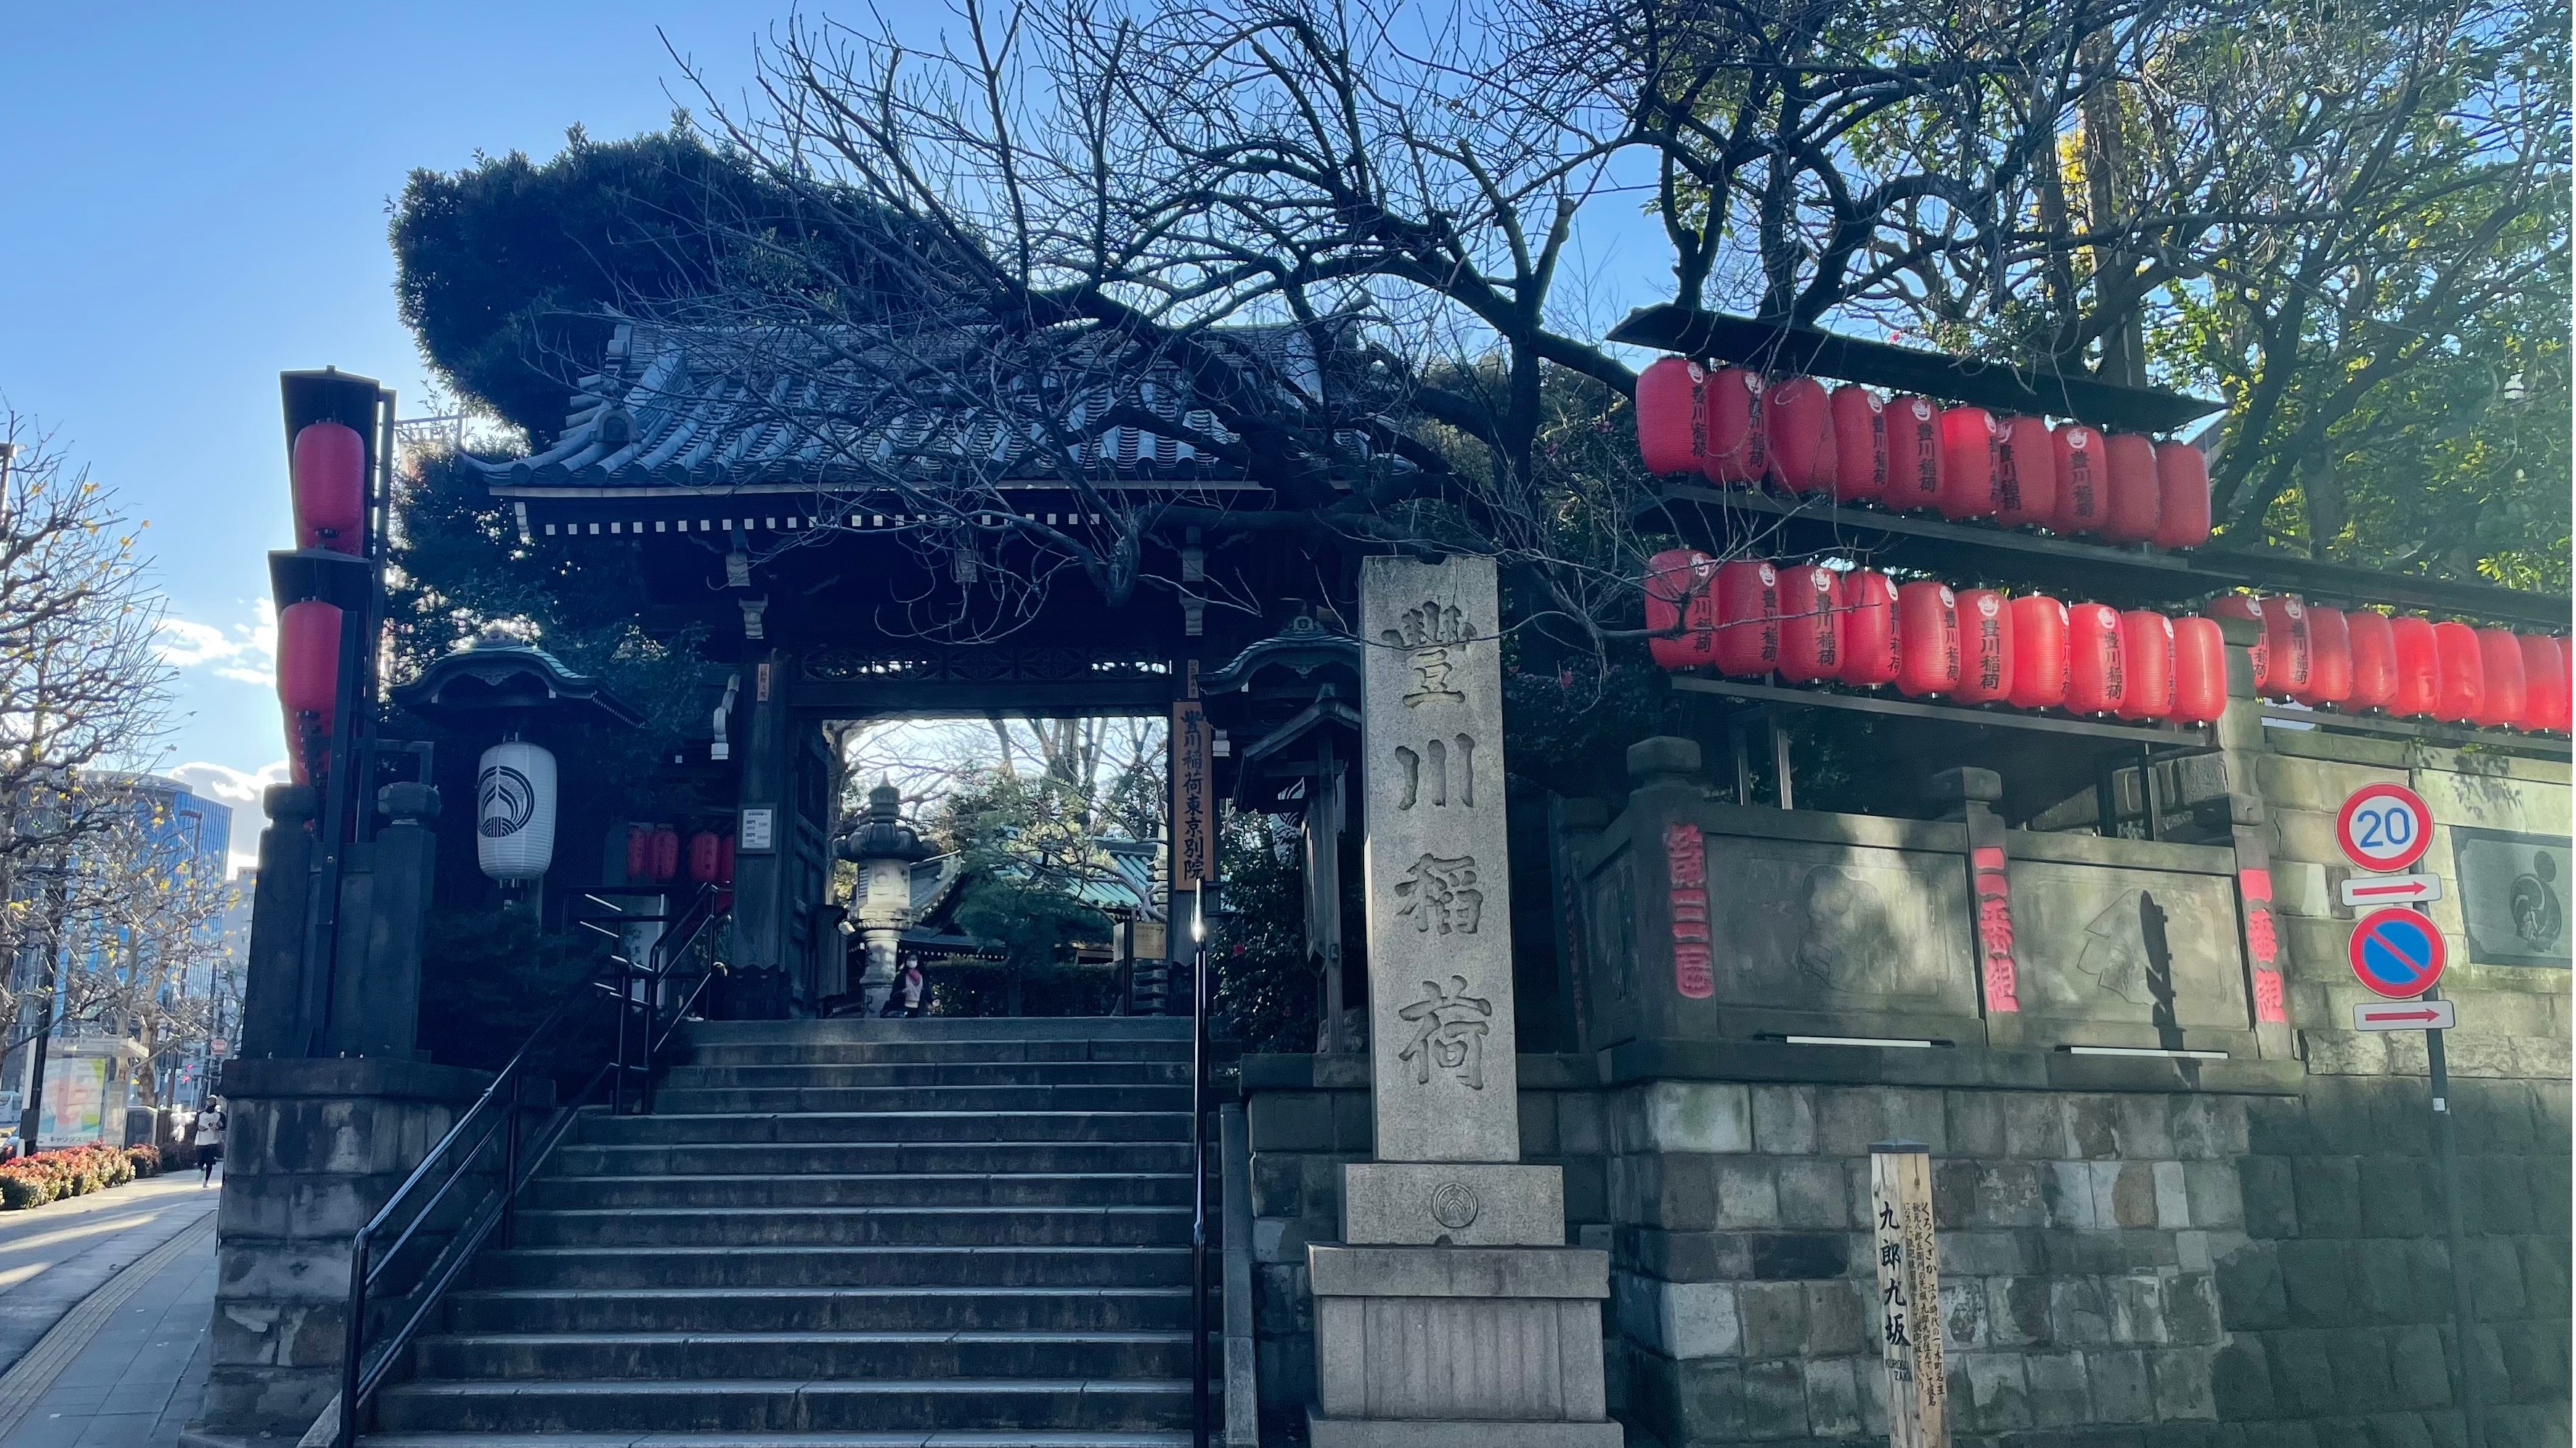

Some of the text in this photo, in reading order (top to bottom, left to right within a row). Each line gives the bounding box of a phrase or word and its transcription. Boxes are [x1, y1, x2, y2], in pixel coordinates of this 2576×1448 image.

[1917, 422, 1937, 493] 豊川稲荷
[2071, 449, 2096, 518] 豊川稲荷
[1693, 584, 1712, 652] 川稲荷
[1816, 591, 1835, 666] 豊川稲荷
[1944, 609, 1960, 682] 豊川稲荷
[1980, 618, 2000, 690] 豊川稲荷
[2103, 631, 2123, 700] 豊川稲荷
[2357, 807, 2410, 848] 20
[1879, 1200, 1912, 1347] 九郎九坂
